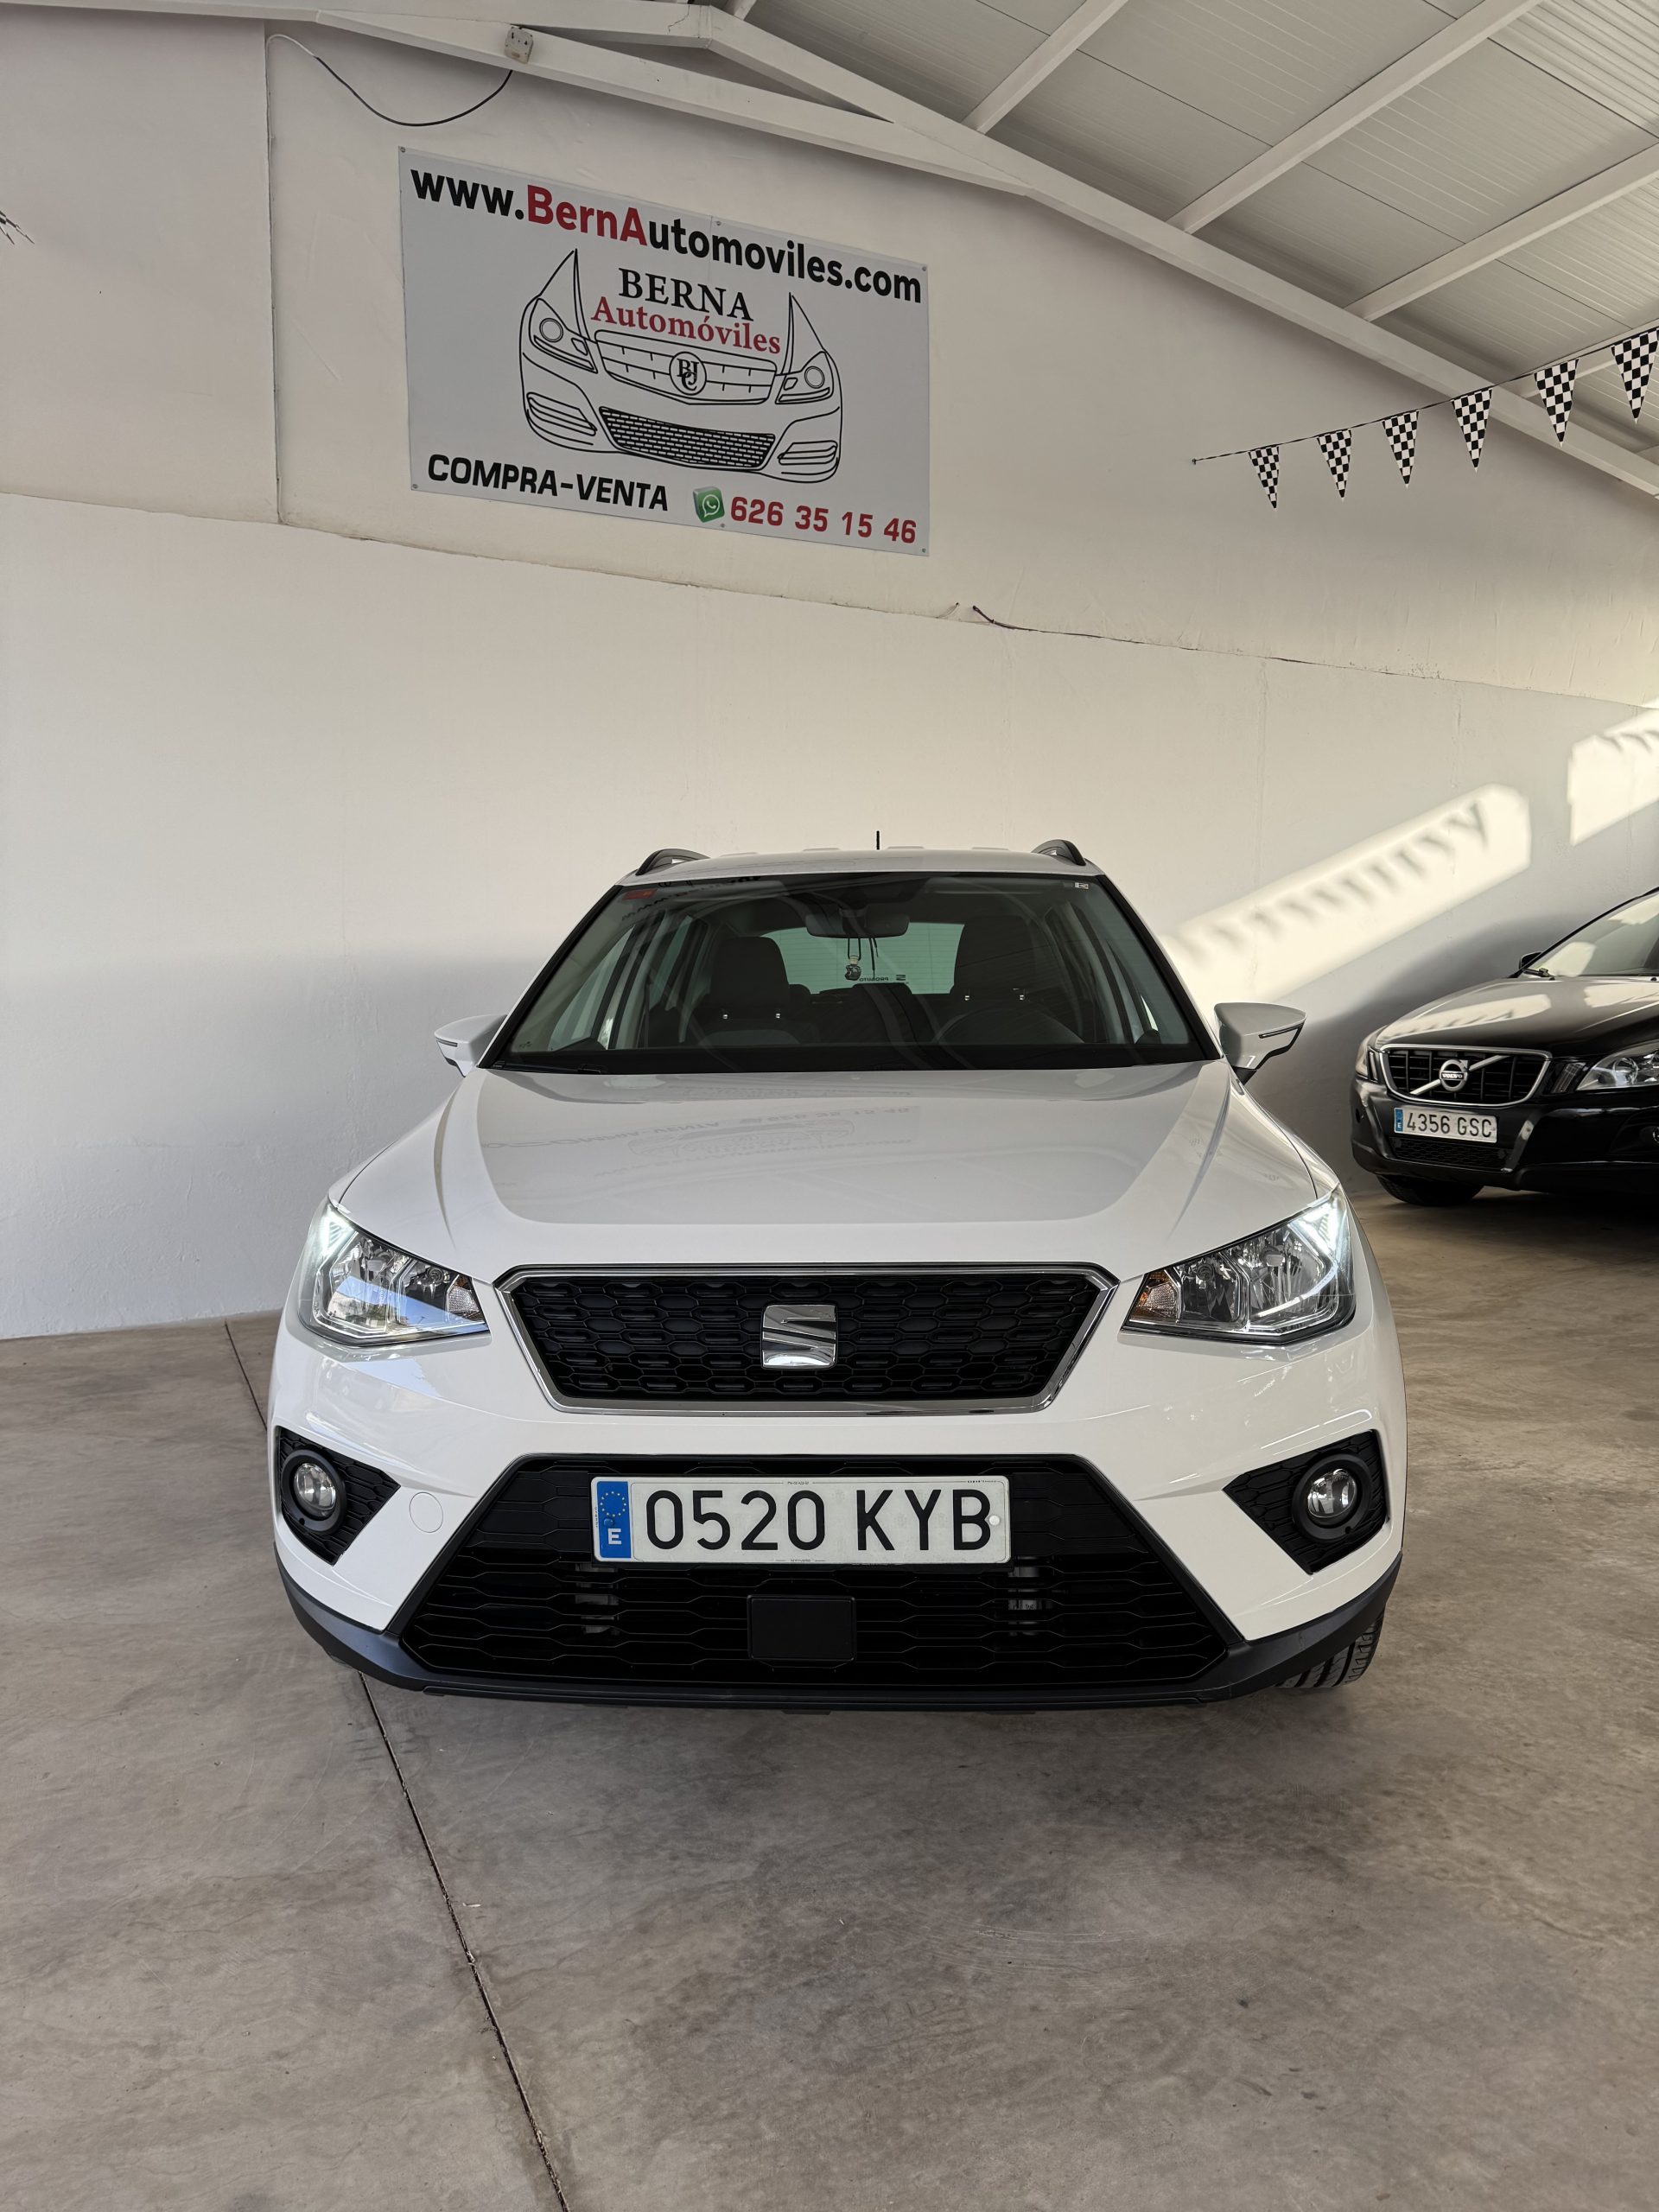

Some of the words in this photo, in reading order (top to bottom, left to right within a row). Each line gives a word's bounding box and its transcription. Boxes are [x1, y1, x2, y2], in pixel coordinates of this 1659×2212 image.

[410, 169, 921, 303] www.BernAutomoviles.com
[619, 268, 753, 321] BERNA
[591, 296, 780, 353] Automóviles
[428, 454, 669, 512] COMPRA-VENTA
[730, 497, 784, 525] 626
[795, 505, 829, 532] 35
[841, 512, 873, 537] 15
[883, 518, 917, 543] 46
[1407, 1113, 1450, 1134] 4356
[1458, 1117, 1491, 1137] GSC
[607, 1528, 622, 1545] E
[645, 1490, 826, 1551] 0520
[855, 1489, 992, 1551] KYB
